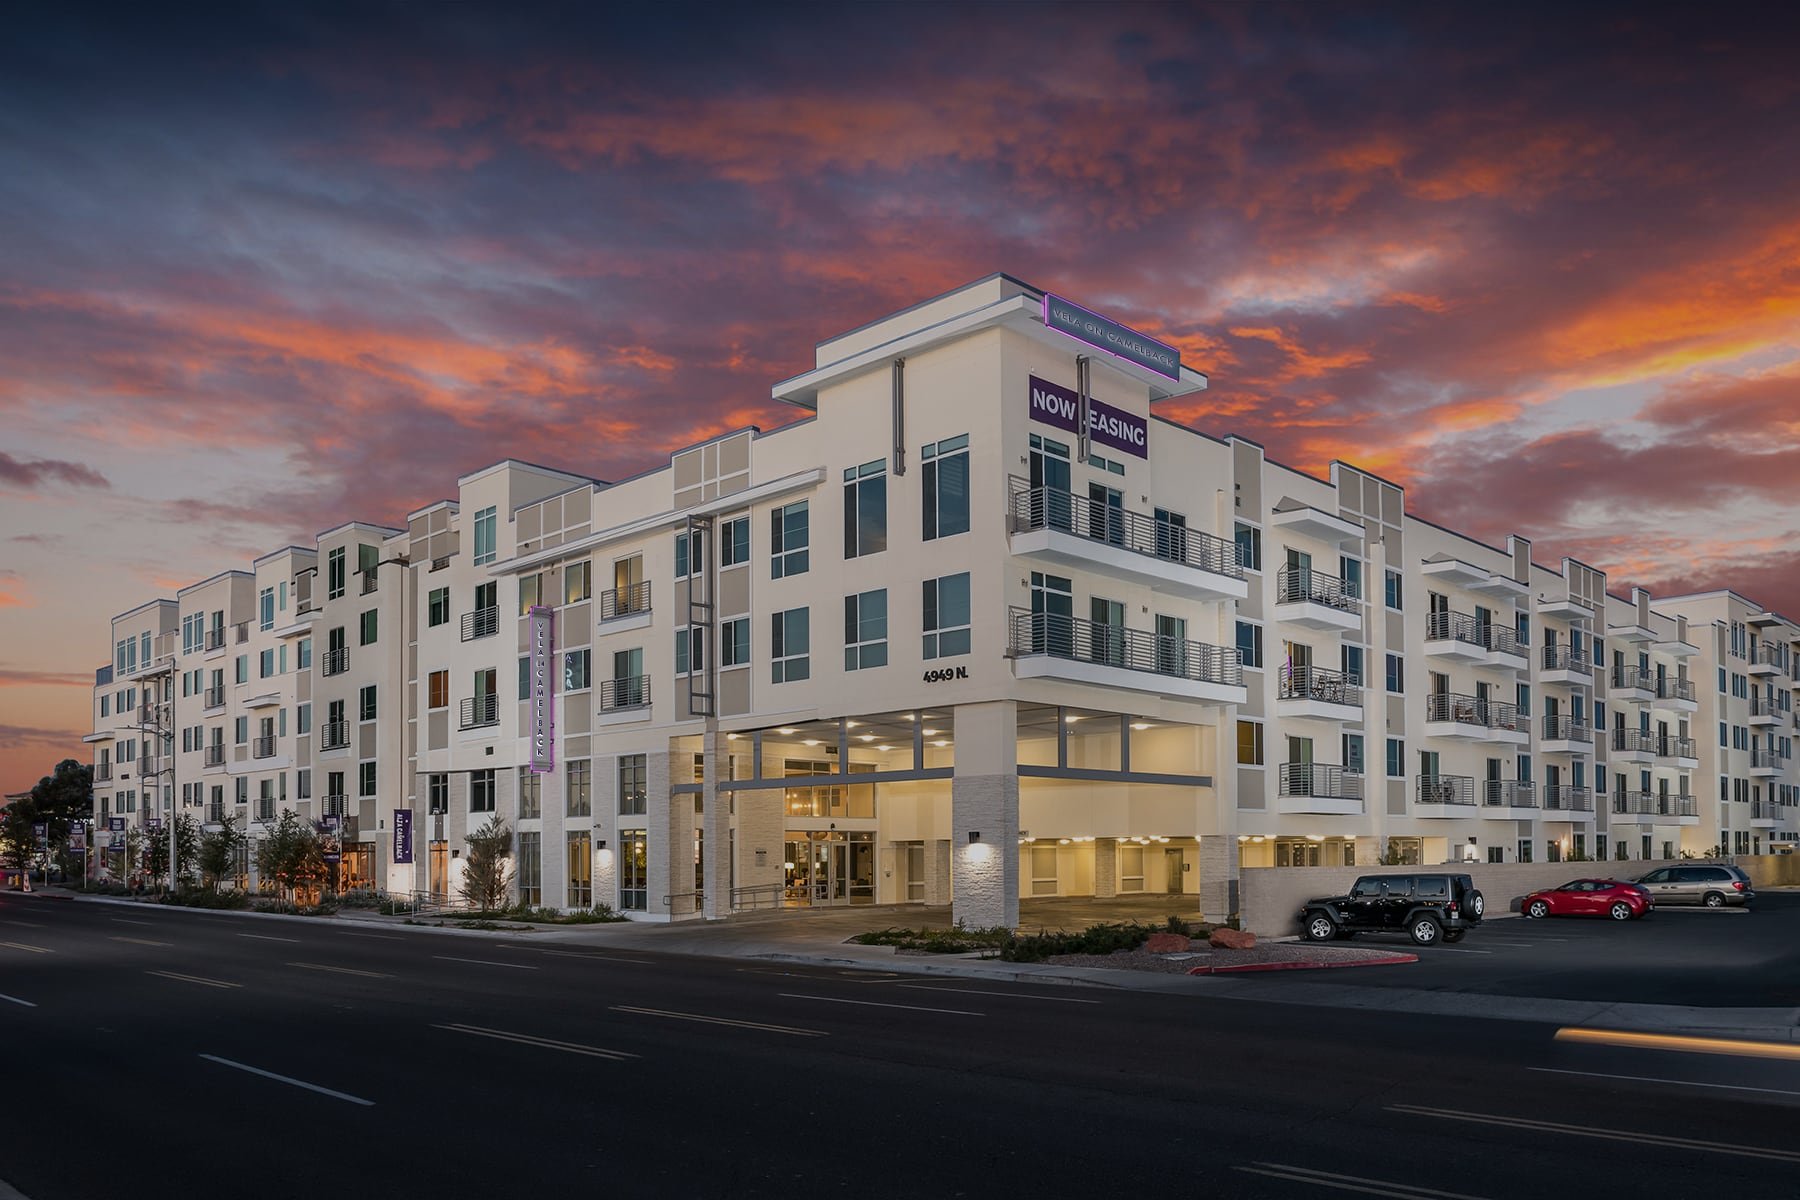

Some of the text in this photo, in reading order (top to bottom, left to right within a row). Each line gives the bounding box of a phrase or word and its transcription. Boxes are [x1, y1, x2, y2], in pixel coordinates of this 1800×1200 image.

[1053, 308, 1174, 368] VELA ON CAMELBACK
[1033, 387, 1145, 446] NOW EASING
[923, 666, 968, 683] 4949 N.
[536, 669, 544, 757] CAMELBACK
